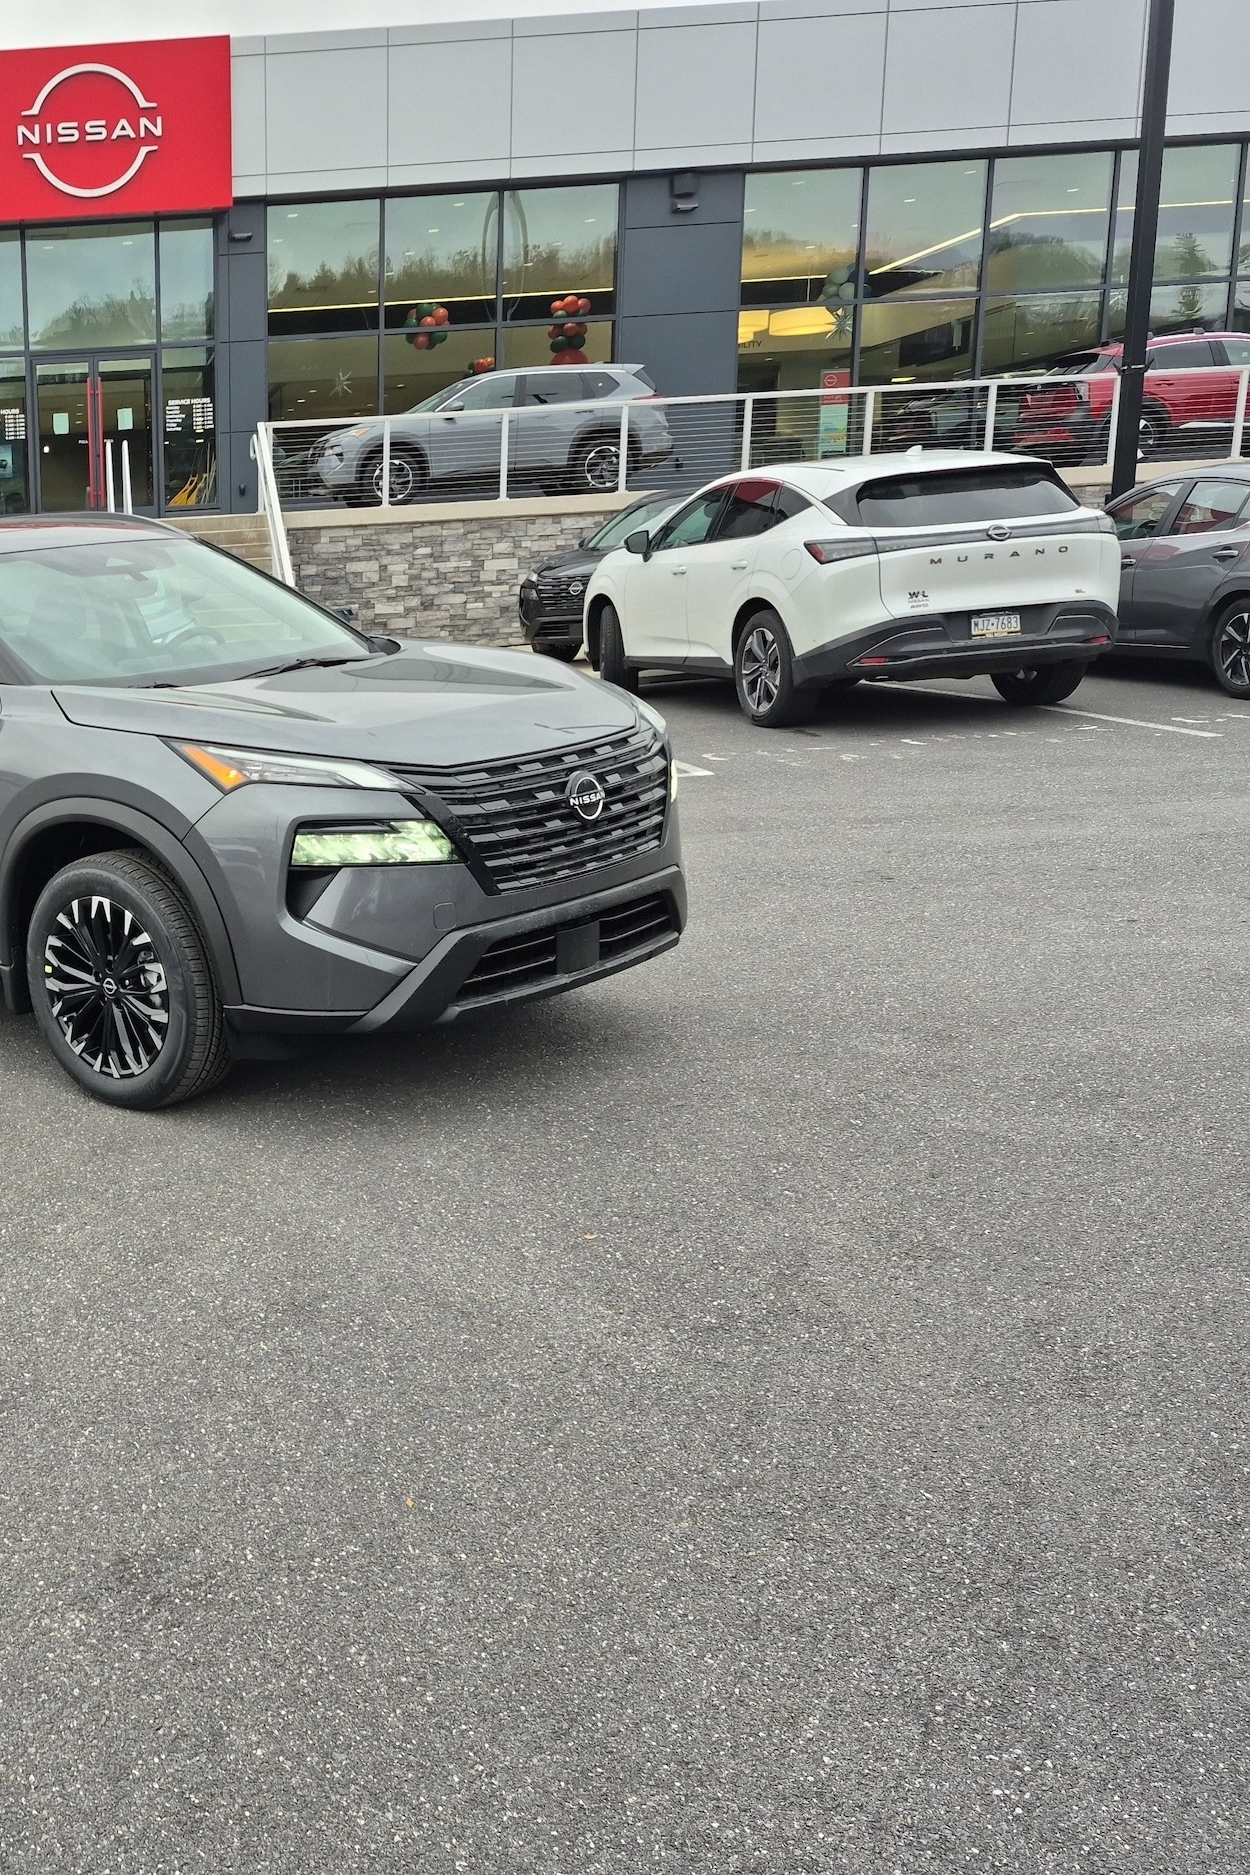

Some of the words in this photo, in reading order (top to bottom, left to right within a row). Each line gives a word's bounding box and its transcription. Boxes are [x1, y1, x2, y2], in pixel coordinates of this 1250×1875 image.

[17, 116, 163, 145] NISSAN
[929, 546, 1069, 565] MURANO
[570, 791, 605, 806] NISSAN
